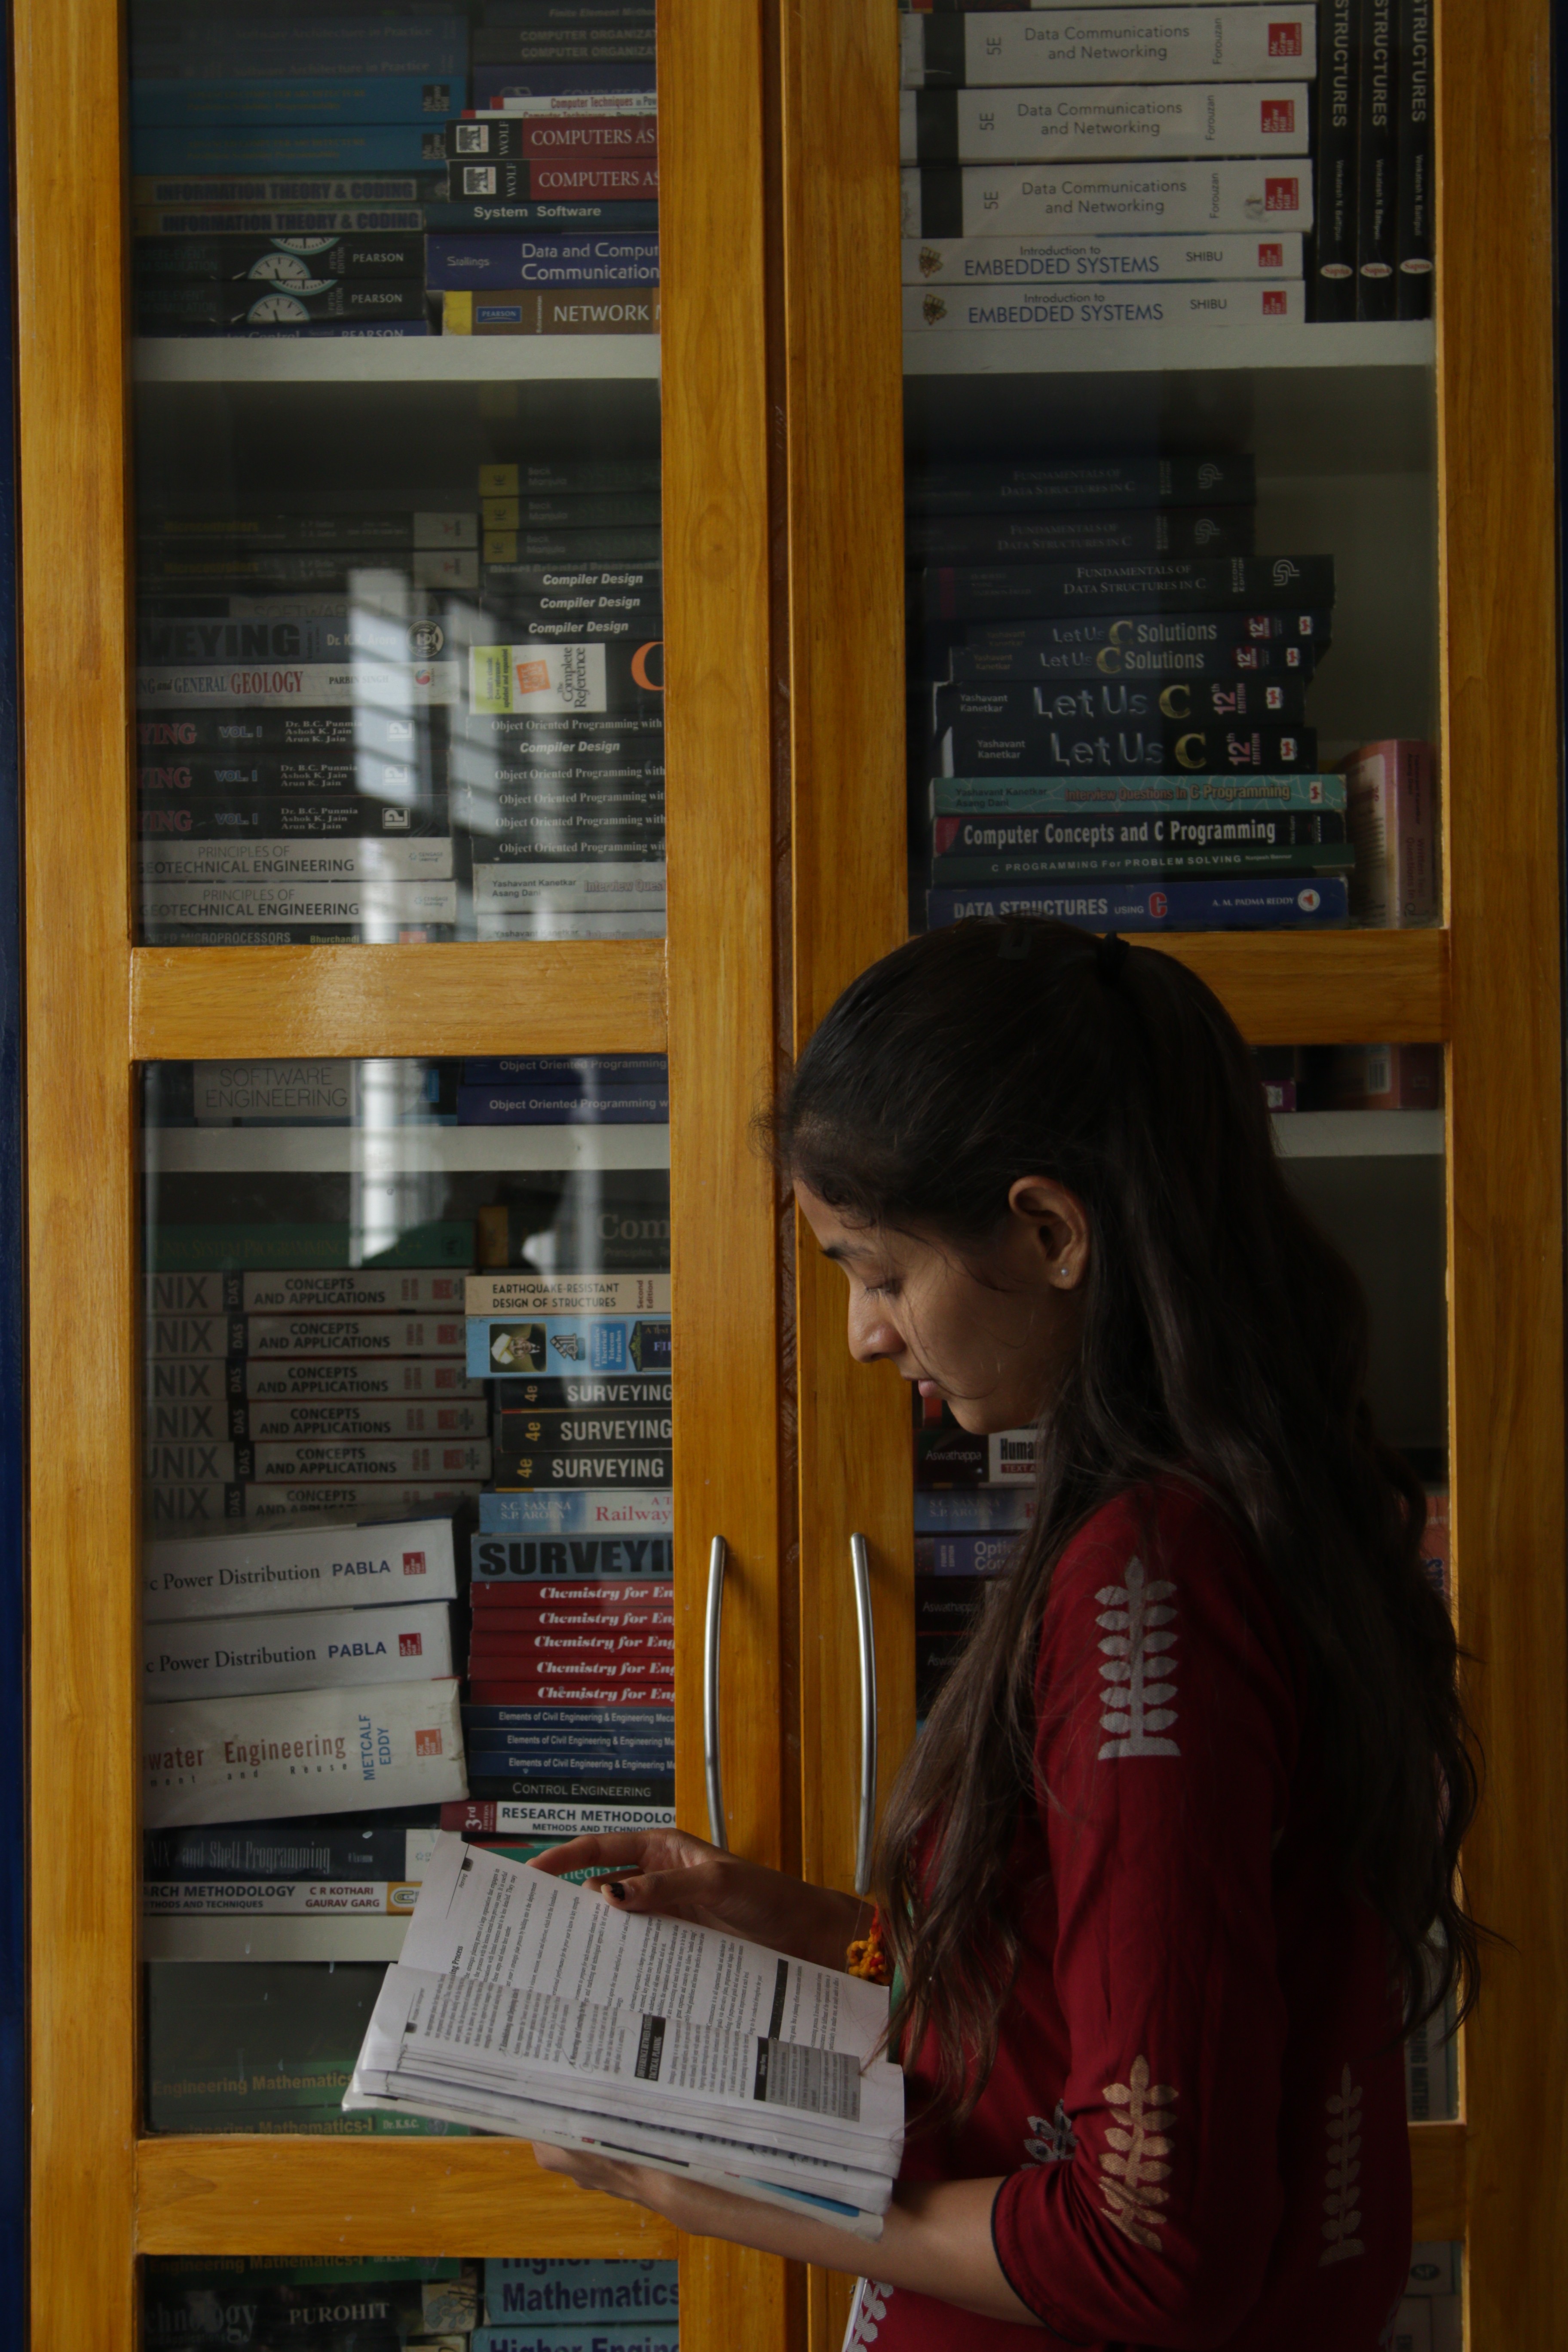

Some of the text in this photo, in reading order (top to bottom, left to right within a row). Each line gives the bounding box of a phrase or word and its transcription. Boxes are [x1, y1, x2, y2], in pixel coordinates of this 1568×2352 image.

[1025, 24, 1189, 41] Data Communications
[1213, 18, 1222, 64] Forouzan
[987, 37, 1001, 55] 5E
[1048, 45, 1167, 60] and Networking
[499, 120, 509, 156] WOLF
[531, 129, 655, 146] COMPUTERS AS
[539, 172, 639, 187] COMPUTERS
[1022, 180, 1186, 194] Data Communications
[984, 191, 998, 209] 5E
[1210, 173, 1219, 218] Forouzan
[474, 206, 602, 220] System Software
[1046, 199, 1164, 214] and Networking
[162, 213, 420, 231] INFORMATION THEORY & CODING
[352, 253, 404, 263] PEARSON
[522, 243, 558, 258] Data
[562, 244, 591, 257] and
[1021, 246, 1101, 255] Introduction to
[1186, 252, 1223, 261] SHIBU
[447, 256, 490, 269] Stallings
[964, 256, 1159, 276] EMBEDDED SYSTEMS
[351, 294, 402, 303] PEARSON
[1024, 293, 1105, 303] Introduction to
[1190, 299, 1227, 309] SHIBU
[554, 305, 649, 322] NETWORK
[968, 304, 1163, 323] EMBEDDED SYSTEMS
[543, 573, 643, 587] Compiler Design
[1077, 565, 1191, 578] FUNDAMENTALS OF
[1064, 578, 1207, 595] DATA STRUCTURES IN C
[540, 597, 640, 610] Compiler Design
[529, 621, 629, 635] Compiler Design
[1137, 624, 1217, 643] Solutions
[1040, 646, 1205, 674] Let Us C Solutions
[230, 671, 303, 695] GEOLOGY
[562, 646, 573, 703] Complete
[575, 647, 586, 709] Reference
[960, 694, 1008, 702] Yashavant
[1034, 683, 1191, 719] Let Us C
[1237, 683, 1246, 714] EDITION
[960, 704, 1003, 713] Kanetkar
[492, 718, 662, 732] Object Oriented Programming with
[1050, 732, 1207, 769] Let Us C
[964, 819, 1276, 849] Computer Concepts and C Programming
[198, 845, 290, 858] PRINCIPLES OF
[254, 859, 355, 872] ENGINEERING
[991, 855, 1242, 872] C PROGRAMMING For PROBLEM SOLVING
[954, 898, 1144, 919] DATA STRUCTURES USING
[220, 1067, 332, 1087] SOFTWARE
[206, 1088, 347, 1107] ENGINEERING
[490, 1099, 656, 1112] Object Oriented Programming
[285, 1278, 354, 1290] CONCEPTS
[254, 1291, 386, 1305] AND APPLICATIONS
[493, 1297, 616, 1308] DESIGN OF STRUCTURES
[233, 1323, 244, 1349] DAS
[525, 1421, 541, 1441] 4e
[560, 1419, 672, 1441] SURVEYING
[925, 1449, 982, 1462] Aswathappa
[517, 1458, 533, 1478] 4e
[552, 1458, 664, 1478] SURVEYING
[596, 1506, 670, 1524] Railway
[164, 1560, 391, 1589] Power Distribution PABLA
[540, 1586, 648, 1601] Chemistry for
[534, 1635, 643, 1650] Chemistry for
[160, 1642, 386, 1672] Power Distribution PABLA
[499, 1712, 654, 1724] Elements of Civil Engineering & Engineering
[224, 1734, 346, 1767] Engineering
[358, 1714, 376, 1780] METCALF
[377, 1727, 392, 1765] EDDY
[512, 1782, 652, 1798] CONTROL ENGINEERING
[502, 1807, 576, 1820] RESEARCH
[184, 1886, 296, 1898] METHODOLOGY
[310, 1886, 374, 1896] C R KOTHARI
[306, 1899, 380, 1908] GAURAV GARG
[452, 1945, 464, 1967] Process
[288, 2302, 390, 2325] PUROHIT
